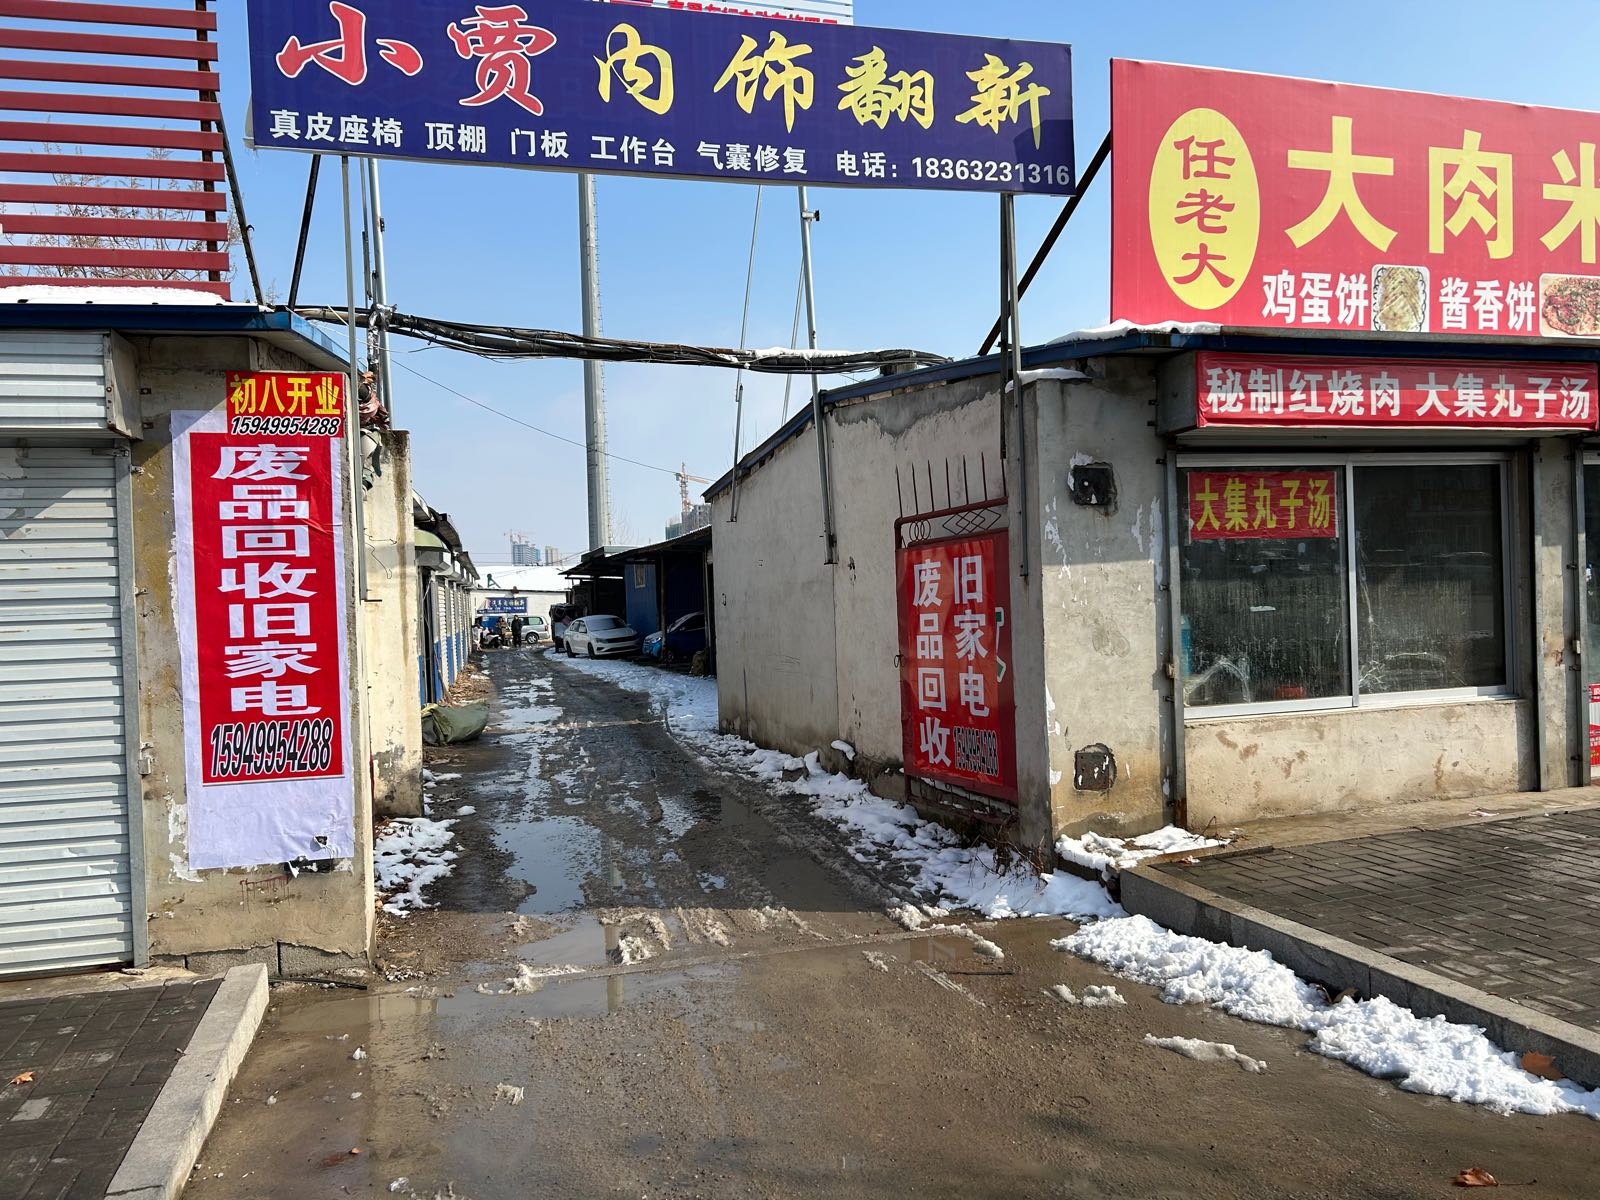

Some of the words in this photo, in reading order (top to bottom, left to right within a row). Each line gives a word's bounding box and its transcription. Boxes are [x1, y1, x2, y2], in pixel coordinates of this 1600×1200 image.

[276, 1, 1050, 150] 小贾内饰翻新
[270, 109, 403, 148] 真皮座椅
[425, 121, 487, 154] 顶棚
[510, 129, 569, 159] 门板
[591, 135, 676, 167] 工作台
[697, 140, 808, 174] 气囊修复
[1172, 135, 1236, 288] 任老大
[1262, 269, 1368, 327] 鸡蛋饼
[1439, 277, 1536, 331] 酱香饼
[230, 374, 341, 416] 初八开业
[1205, 367, 1400, 417] 秘制红烧肉
[1415, 371, 1590, 420] 大集丸子汤
[231, 416, 341, 437] 15949954288
[1195, 477, 1330, 532] 大集丸子汤
[210, 443, 321, 716] 废品回收旧家电
[912, 558, 951, 768] 废品回收
[953, 554, 990, 717] 旧家电
[210, 717, 334, 778] 15949954288
